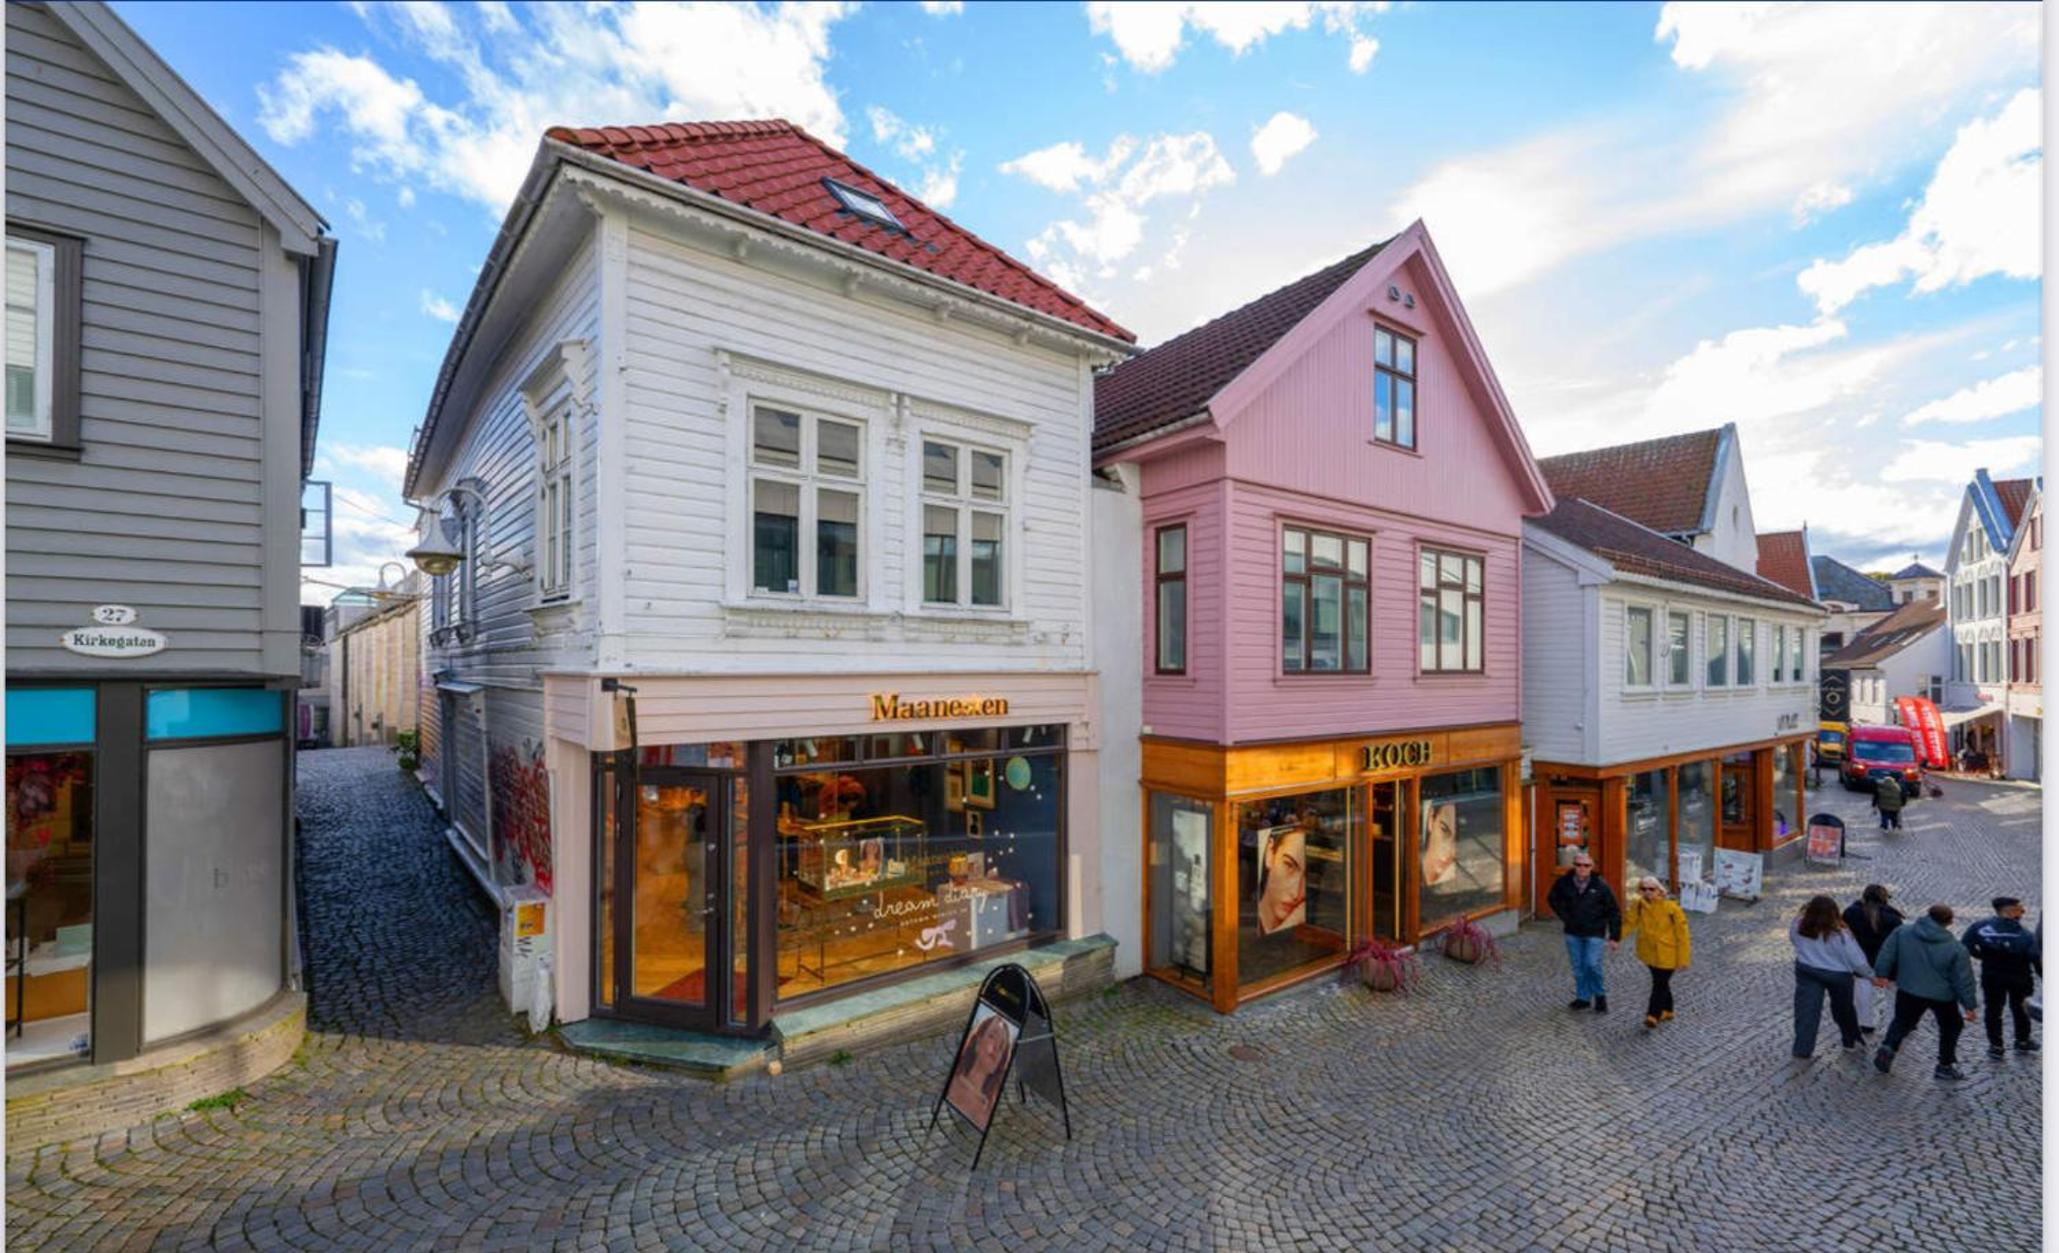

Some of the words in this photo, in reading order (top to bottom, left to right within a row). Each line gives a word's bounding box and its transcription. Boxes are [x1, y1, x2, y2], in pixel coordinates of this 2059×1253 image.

[101, 607, 127, 622] 27
[73, 633, 156, 649] Kirkegaten
[1362, 741, 1432, 770] KOCH
[873, 890, 939, 919] dream
